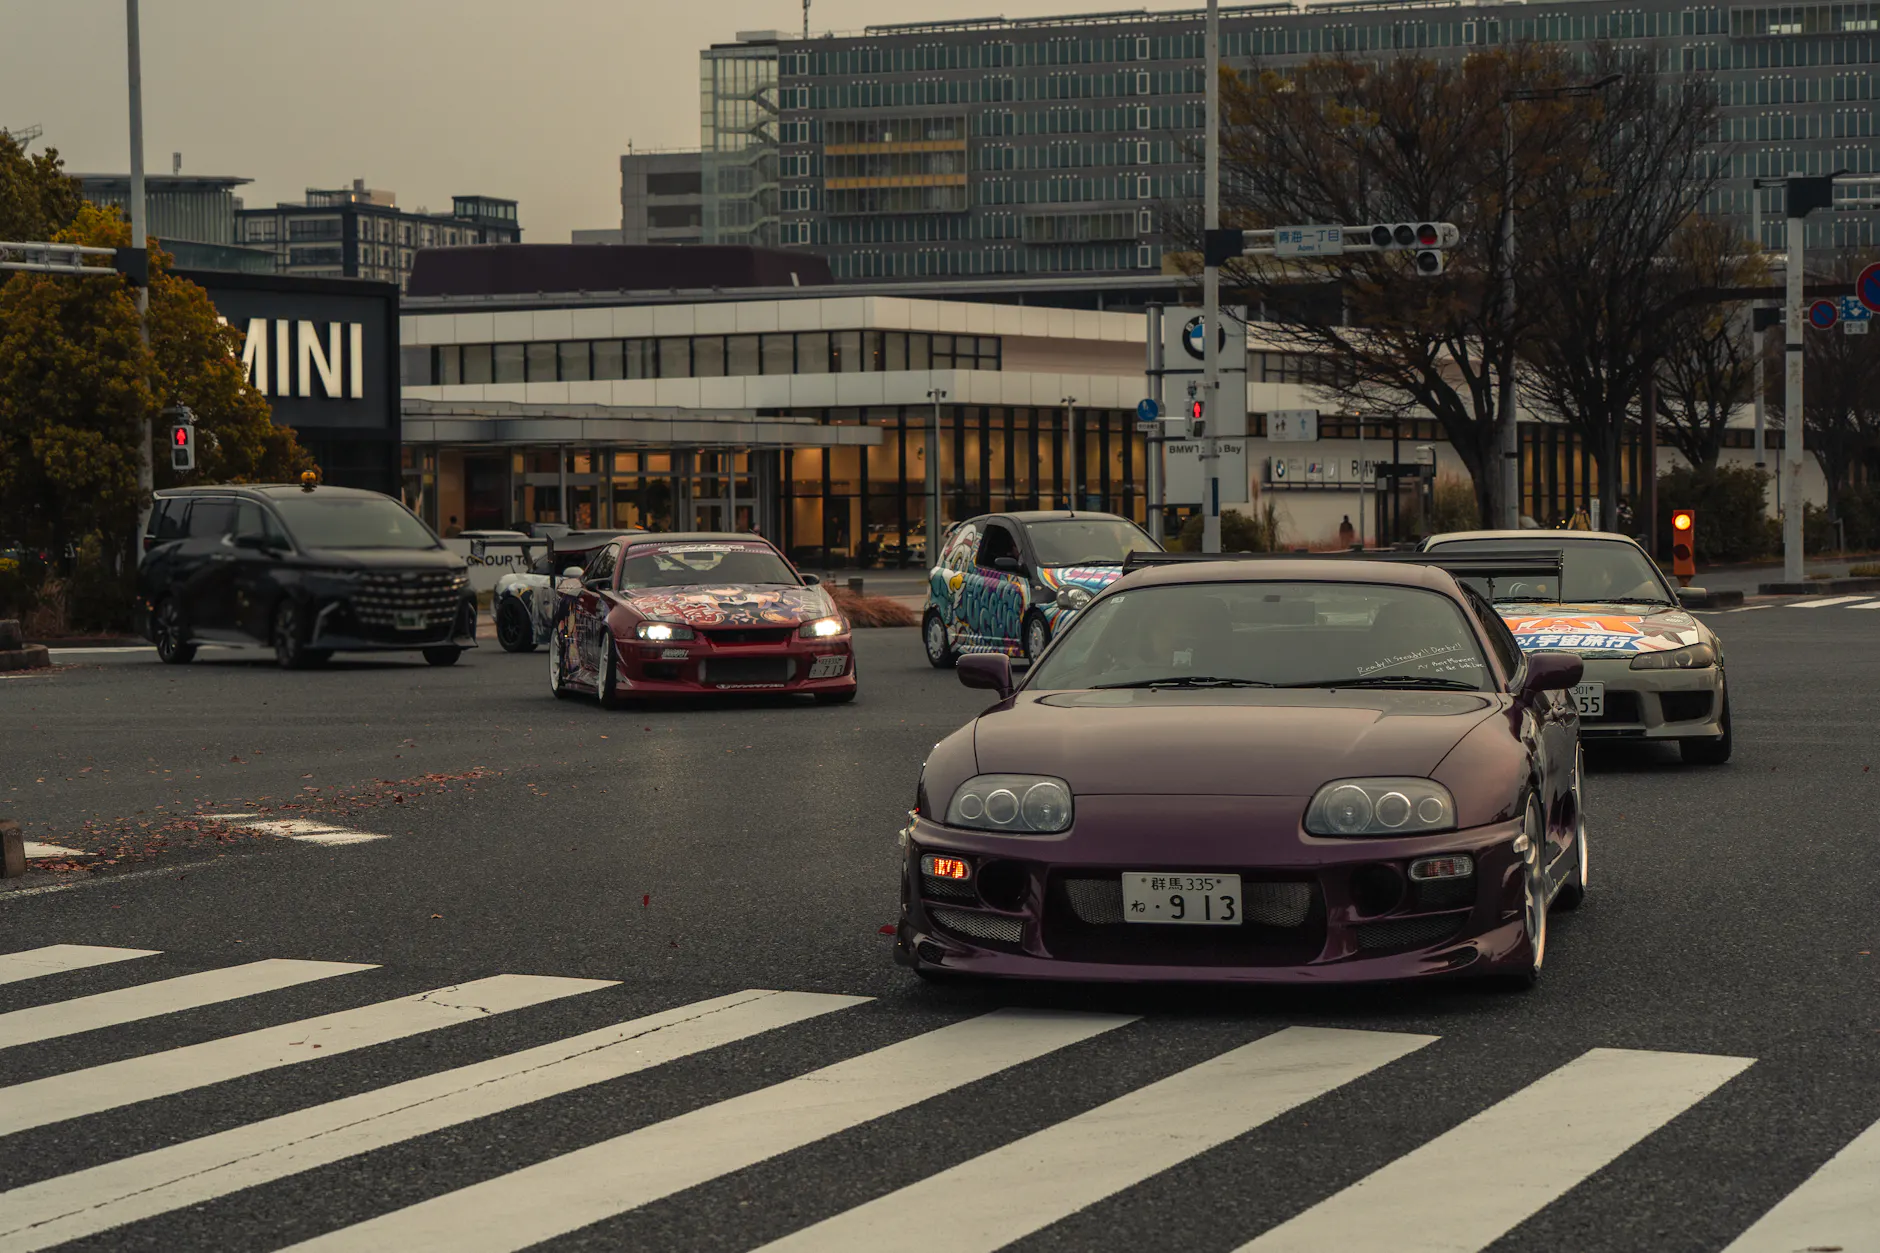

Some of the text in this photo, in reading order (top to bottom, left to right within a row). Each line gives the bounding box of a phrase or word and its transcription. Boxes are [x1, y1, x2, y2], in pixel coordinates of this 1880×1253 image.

[1279, 229, 1339, 243] 青海一丁目
[1169, 445, 1194, 454] BMW
[1224, 444, 1242, 455] Bay
[466, 555, 513, 566] GOUP
[823, 664, 844, 676] 713
[1580, 697, 1600, 713] 55
[1131, 899, 1146, 913] ね
